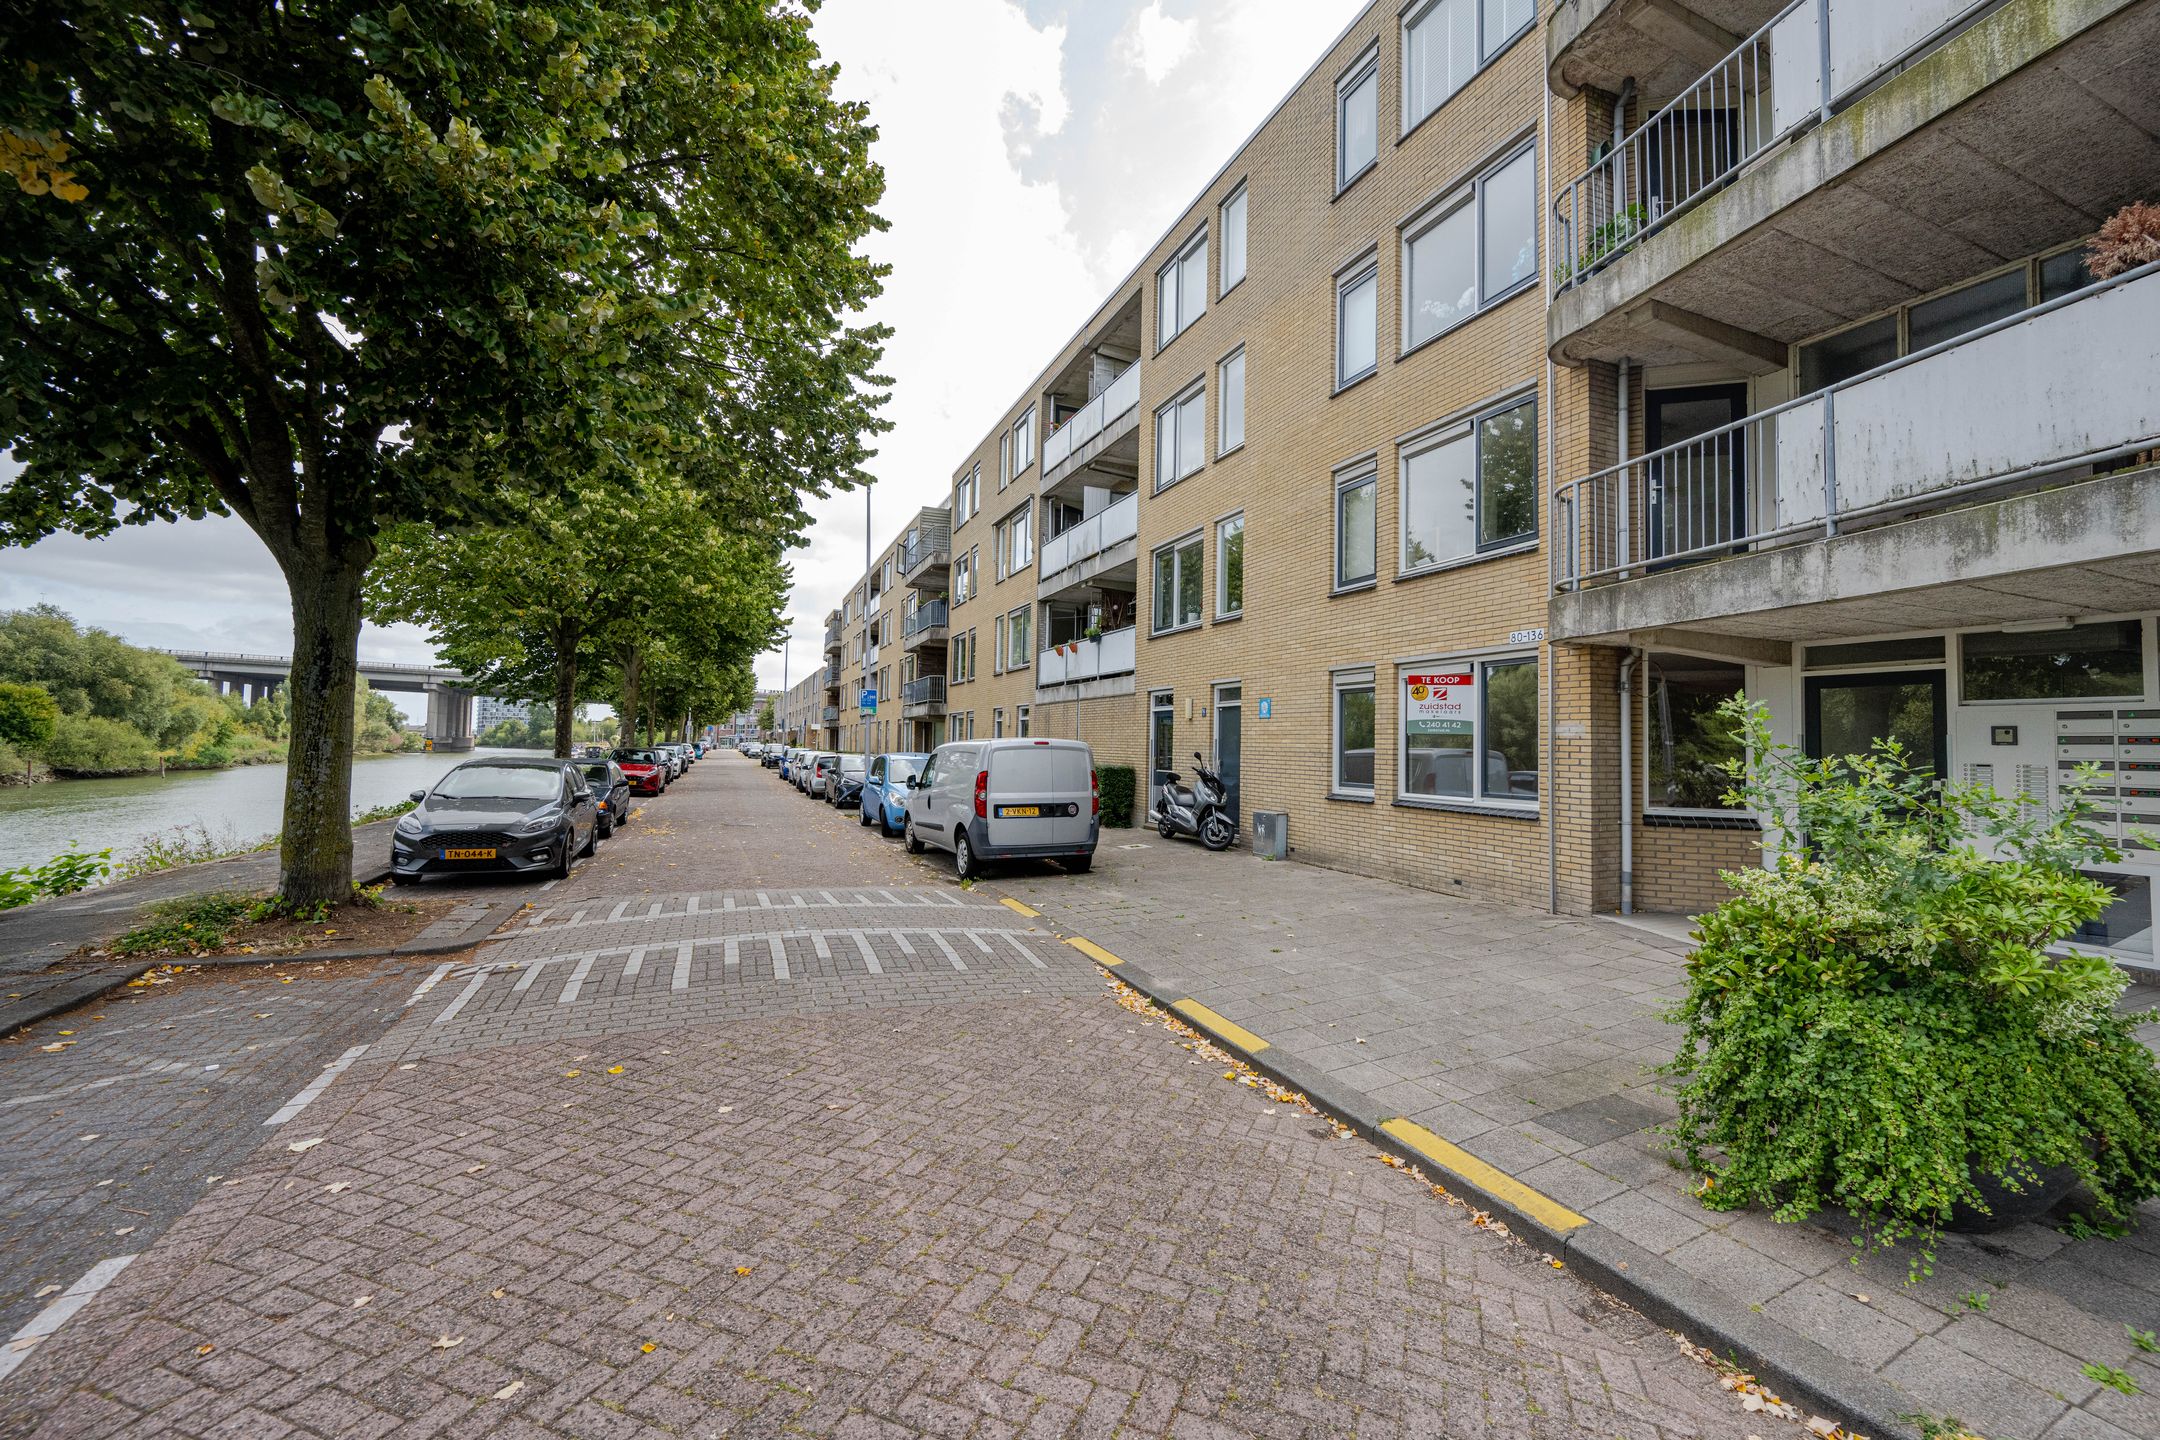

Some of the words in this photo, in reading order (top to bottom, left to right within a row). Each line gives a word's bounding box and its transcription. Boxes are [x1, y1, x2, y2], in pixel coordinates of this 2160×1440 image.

[1510, 630, 1543, 643] 80-136
[861, 690, 868, 699] P
[448, 850, 493, 858] TN-044-K
